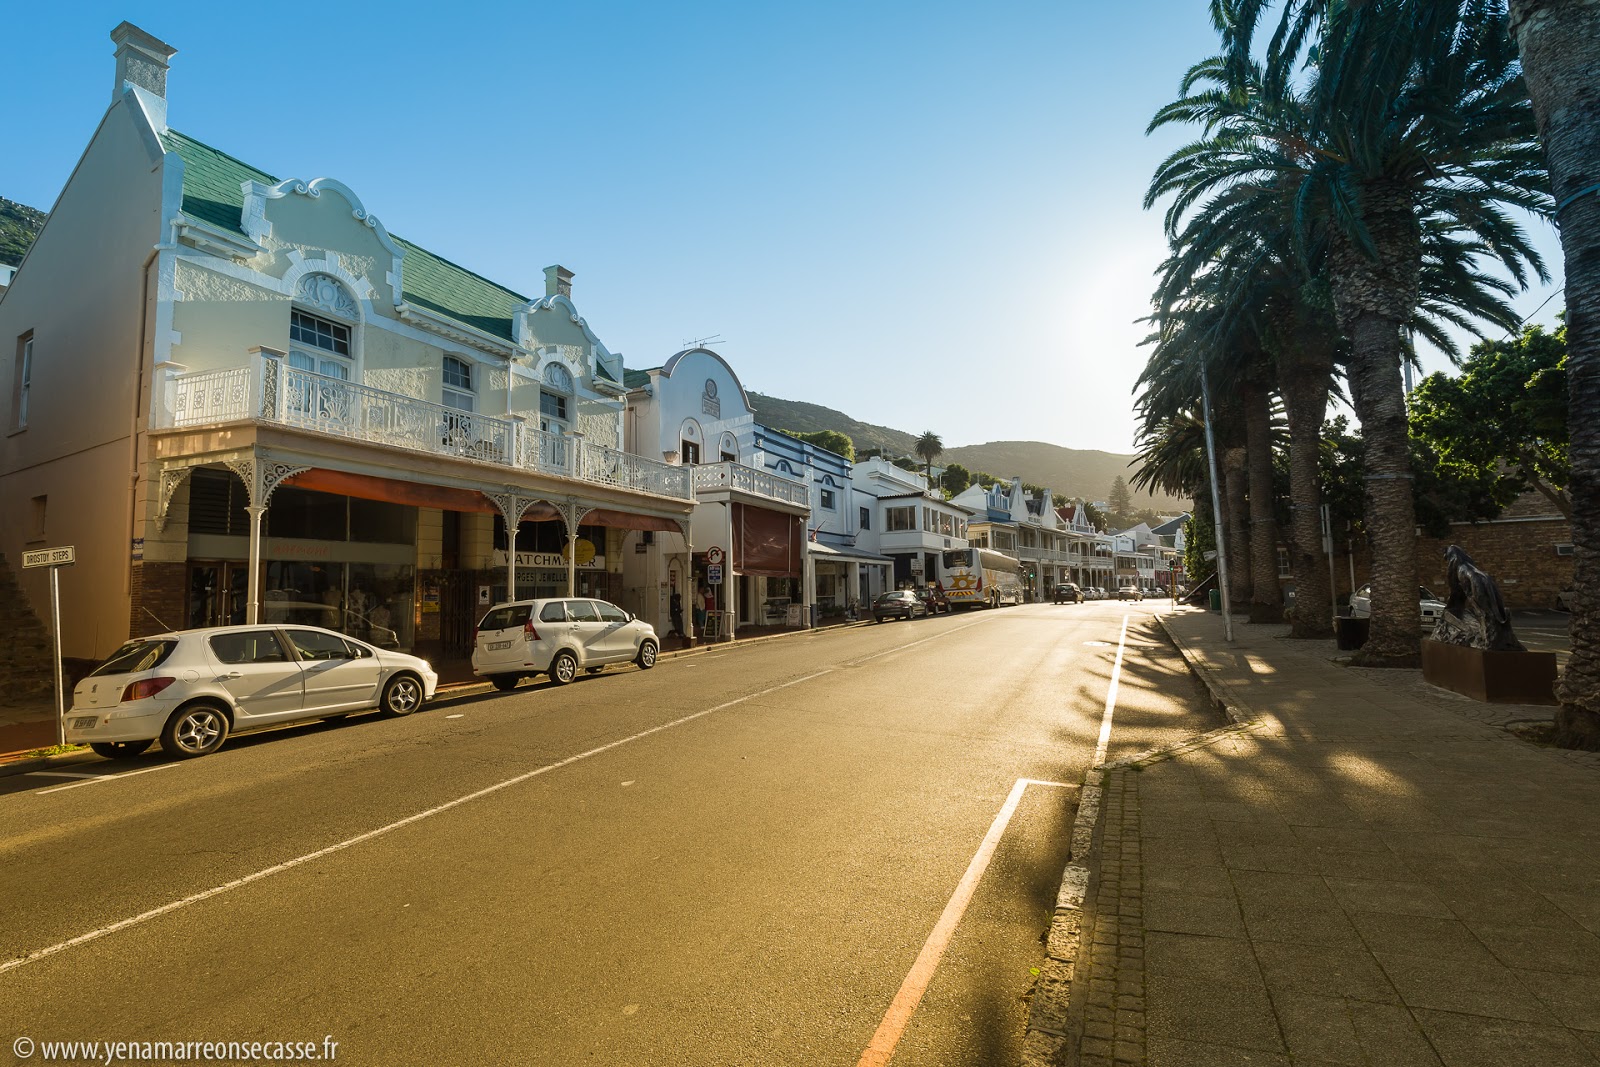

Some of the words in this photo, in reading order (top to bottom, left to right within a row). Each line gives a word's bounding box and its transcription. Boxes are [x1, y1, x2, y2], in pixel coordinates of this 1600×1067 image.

[26, 552, 50, 565] DROSTDY
[52, 550, 69, 561] STEPS
[503, 553, 596, 568] ATCHMR
[504, 572, 534, 583] RGES
[539, 572, 568, 583] JEWELLE
